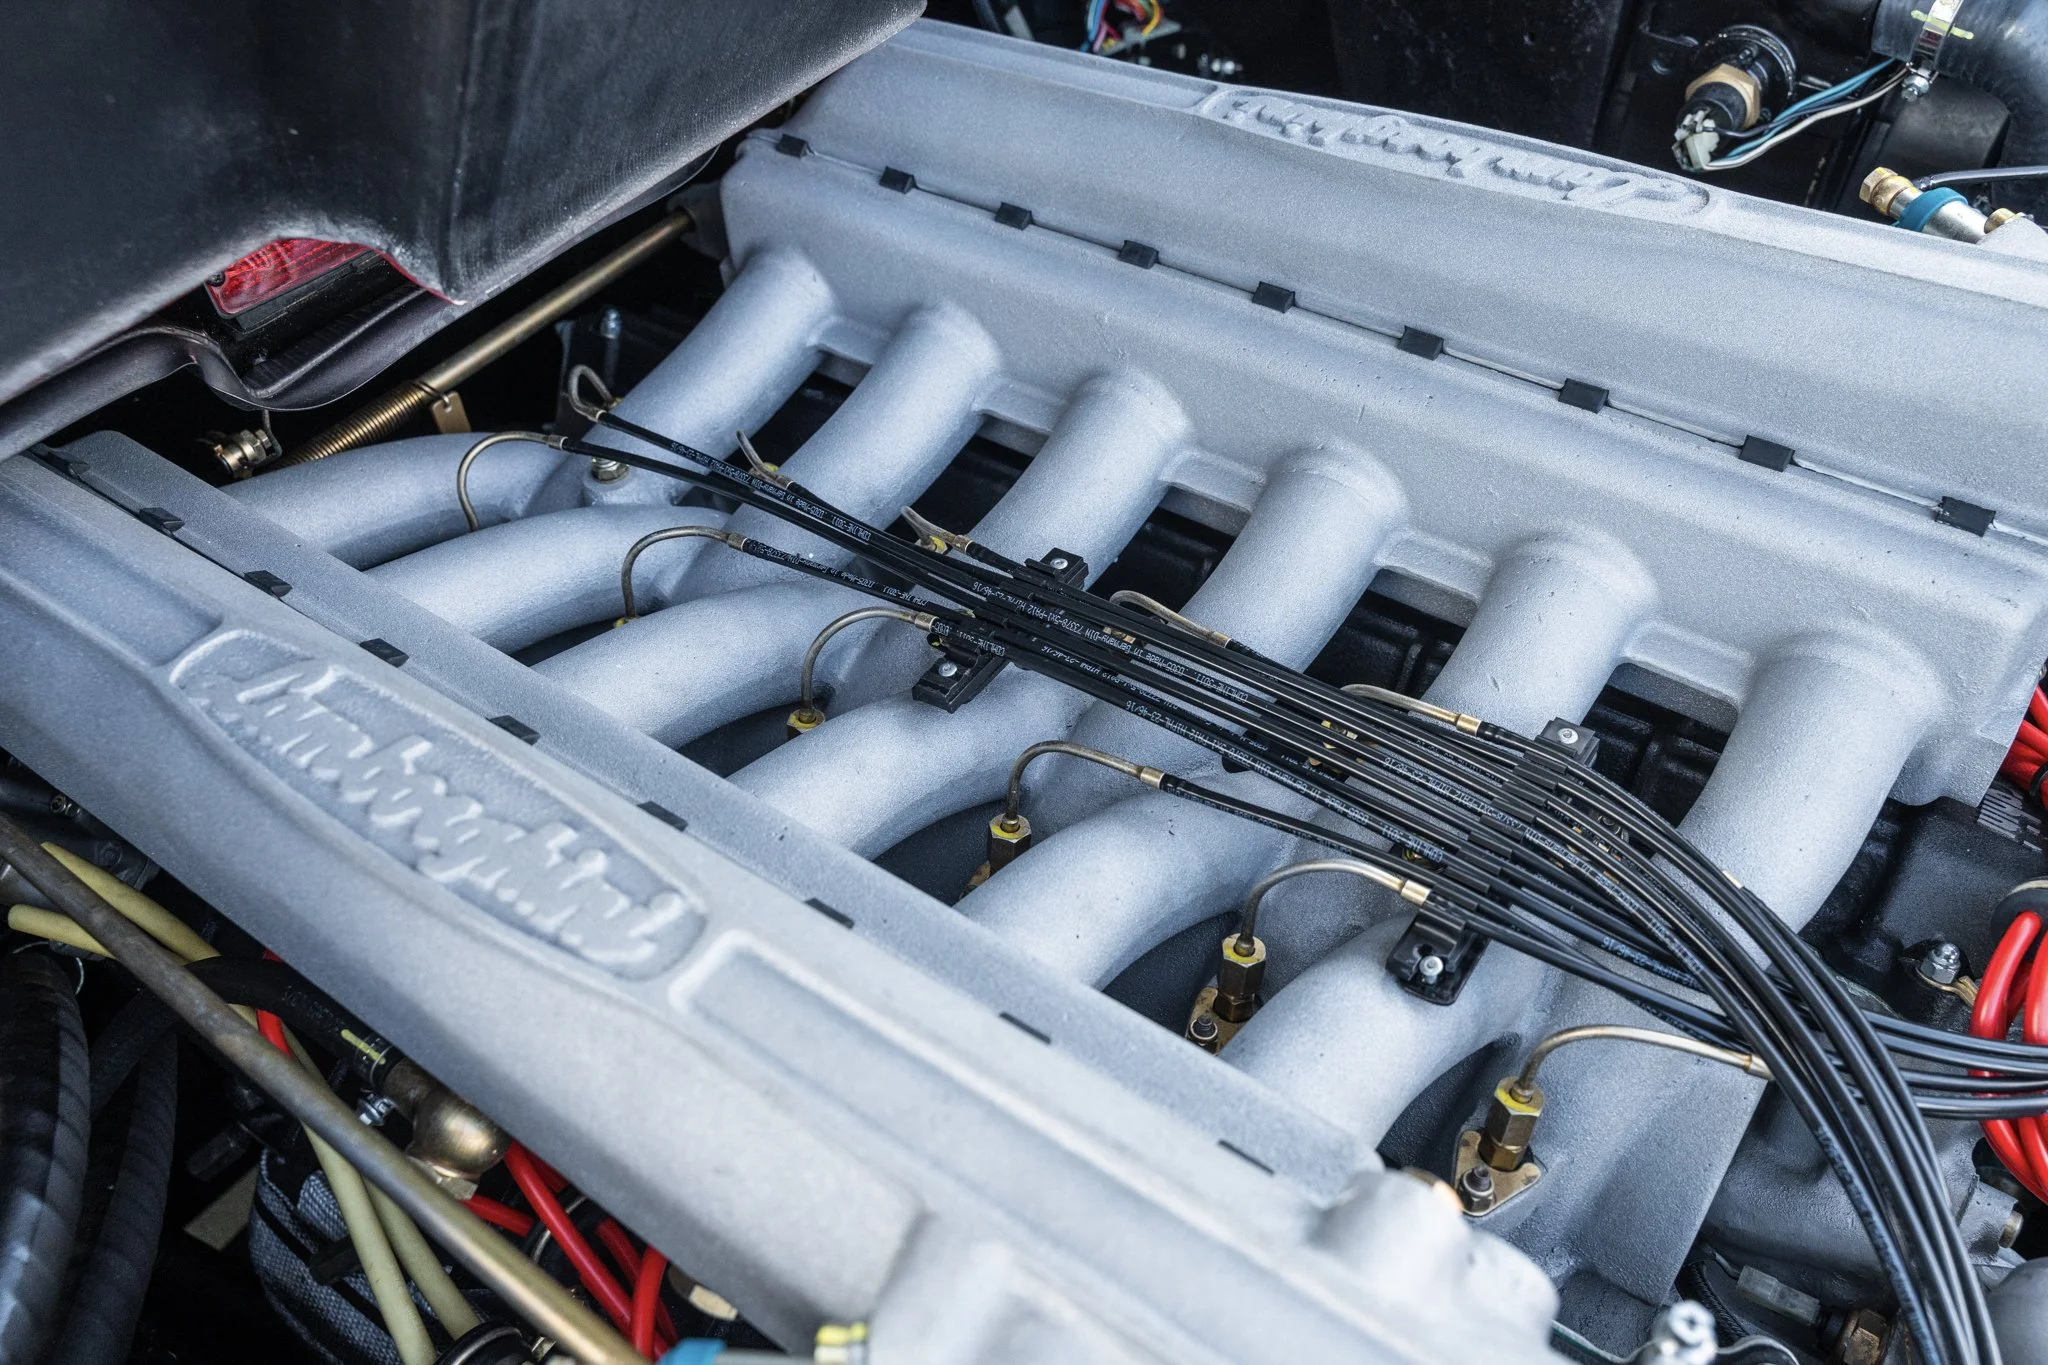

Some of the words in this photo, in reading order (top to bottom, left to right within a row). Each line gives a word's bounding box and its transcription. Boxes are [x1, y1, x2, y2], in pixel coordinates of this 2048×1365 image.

[784, 492, 795, 503] in
[1132, 646, 1144, 658] in
[1307, 786, 1321, 801] in
[184, 664, 690, 966] Lamborghini
